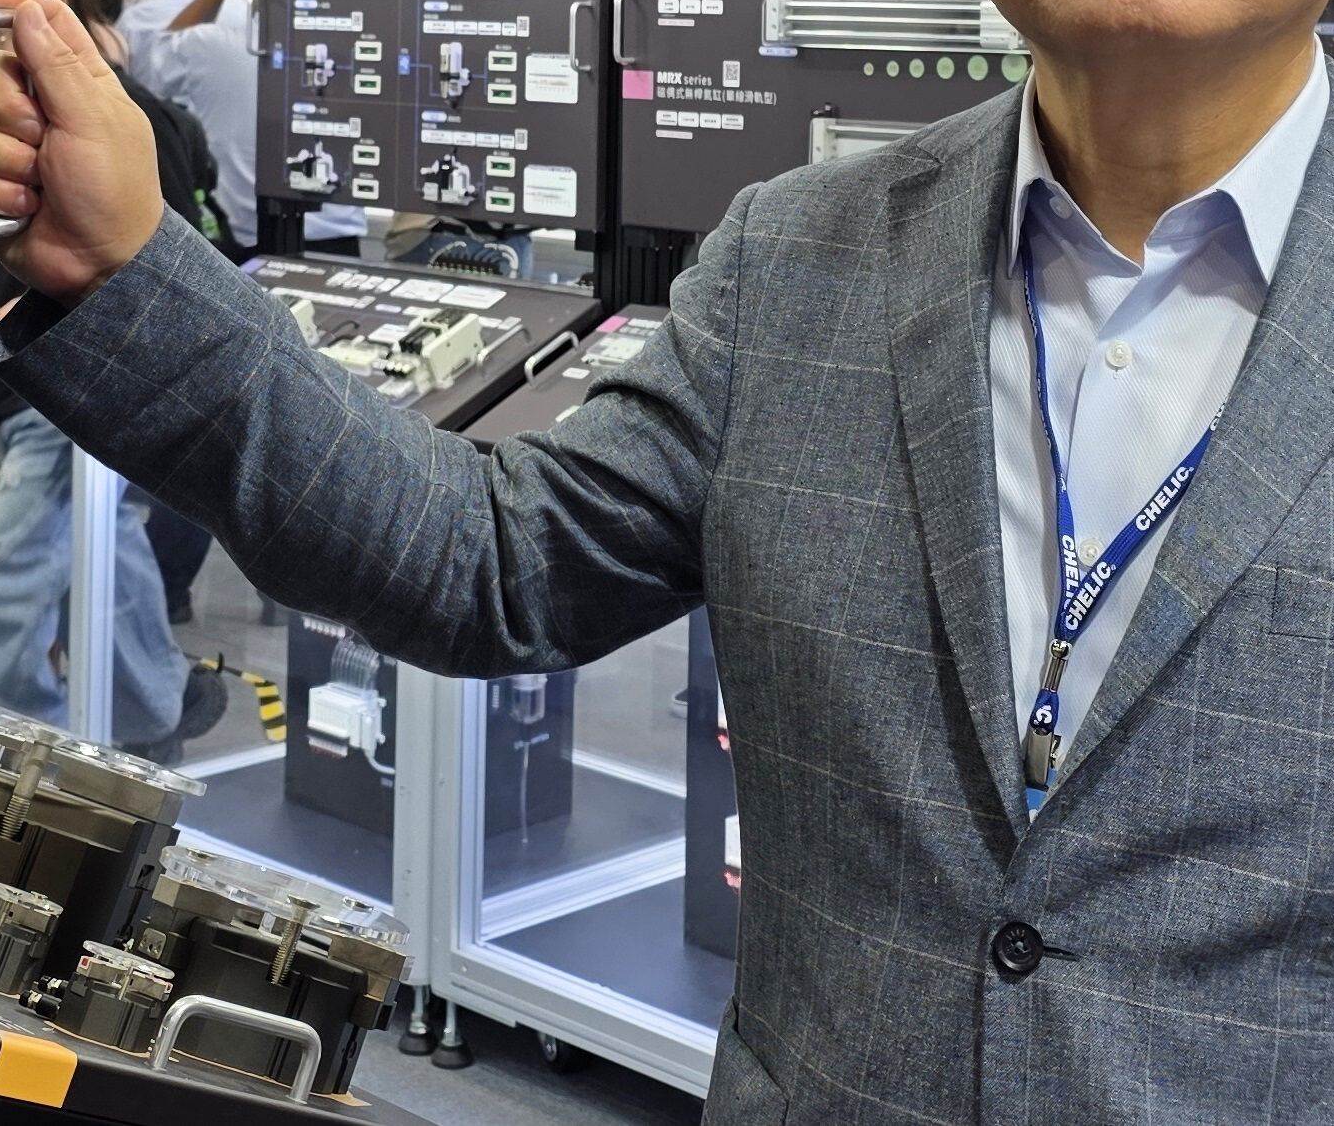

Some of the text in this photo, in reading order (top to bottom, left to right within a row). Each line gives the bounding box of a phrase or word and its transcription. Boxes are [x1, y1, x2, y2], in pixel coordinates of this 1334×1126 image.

[656, 71, 713, 86] MRX series
[1135, 466, 1190, 531] CHELIC
[1065, 561, 1113, 631] CHELIC
